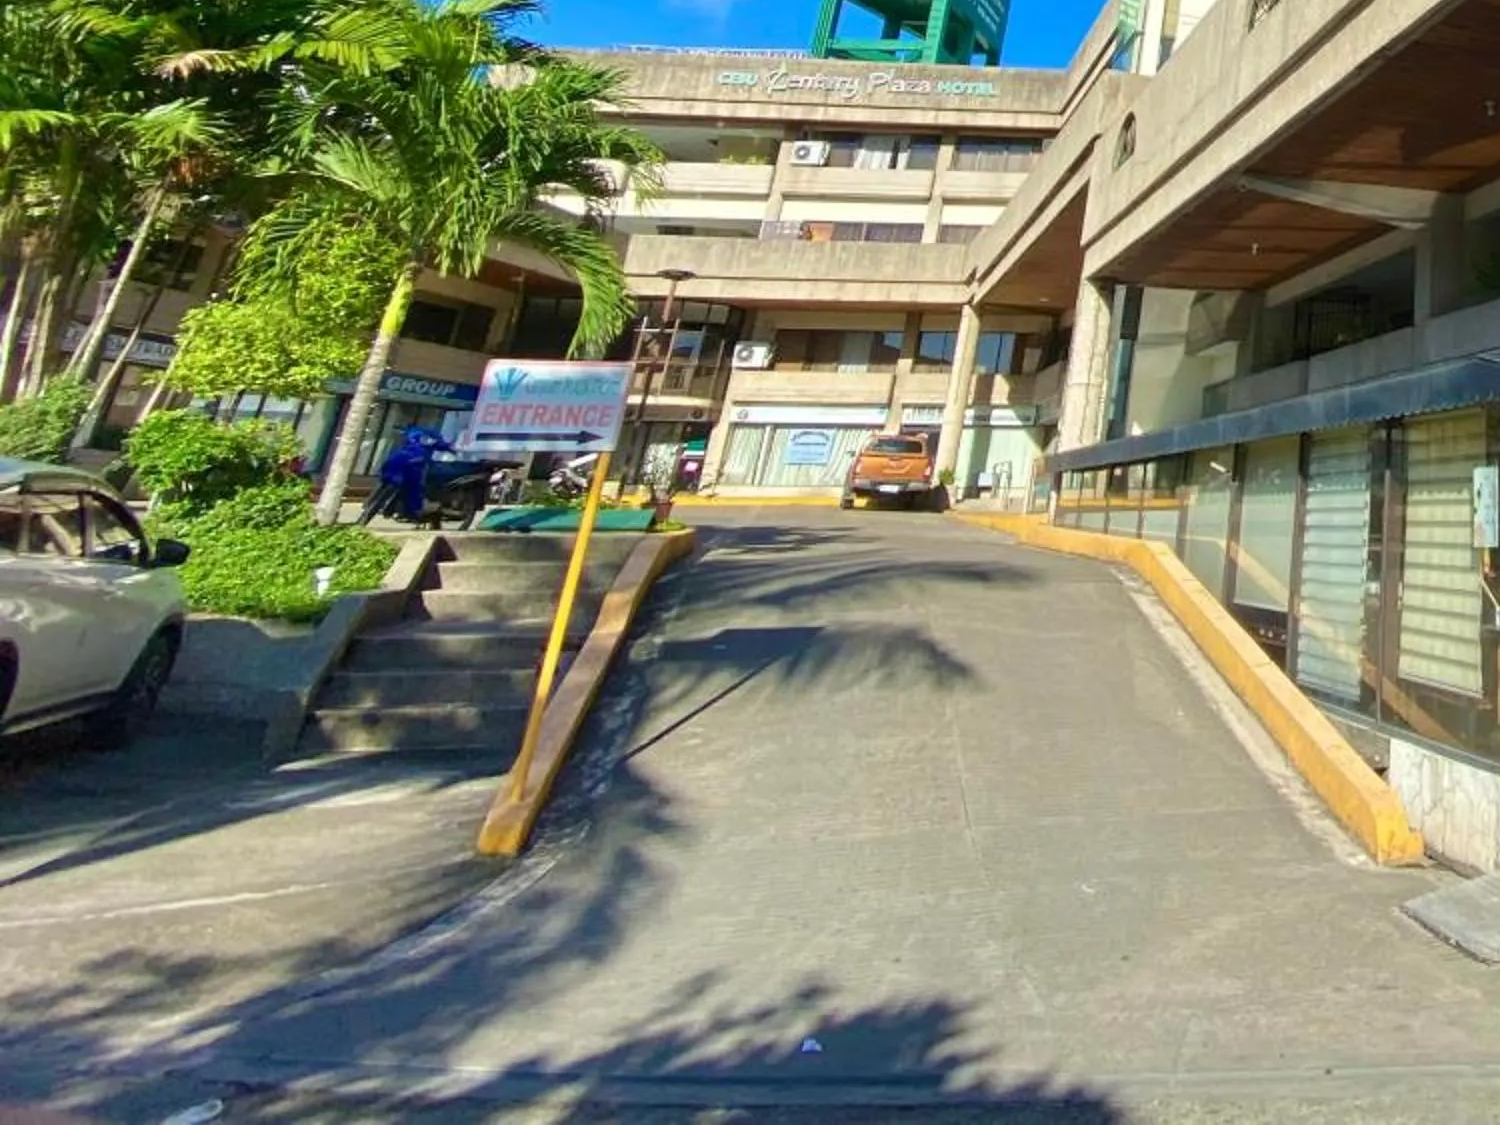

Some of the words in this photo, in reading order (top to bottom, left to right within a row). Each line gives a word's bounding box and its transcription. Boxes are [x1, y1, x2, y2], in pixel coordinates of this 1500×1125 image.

[717, 71, 758, 86] CEBU
[765, 61, 860, 98] Century
[868, 68, 930, 94] Plaza
[936, 80, 997, 96] HOTEL
[386, 376, 457, 396] GROUP
[480, 402, 616, 428] ENTRANCE
